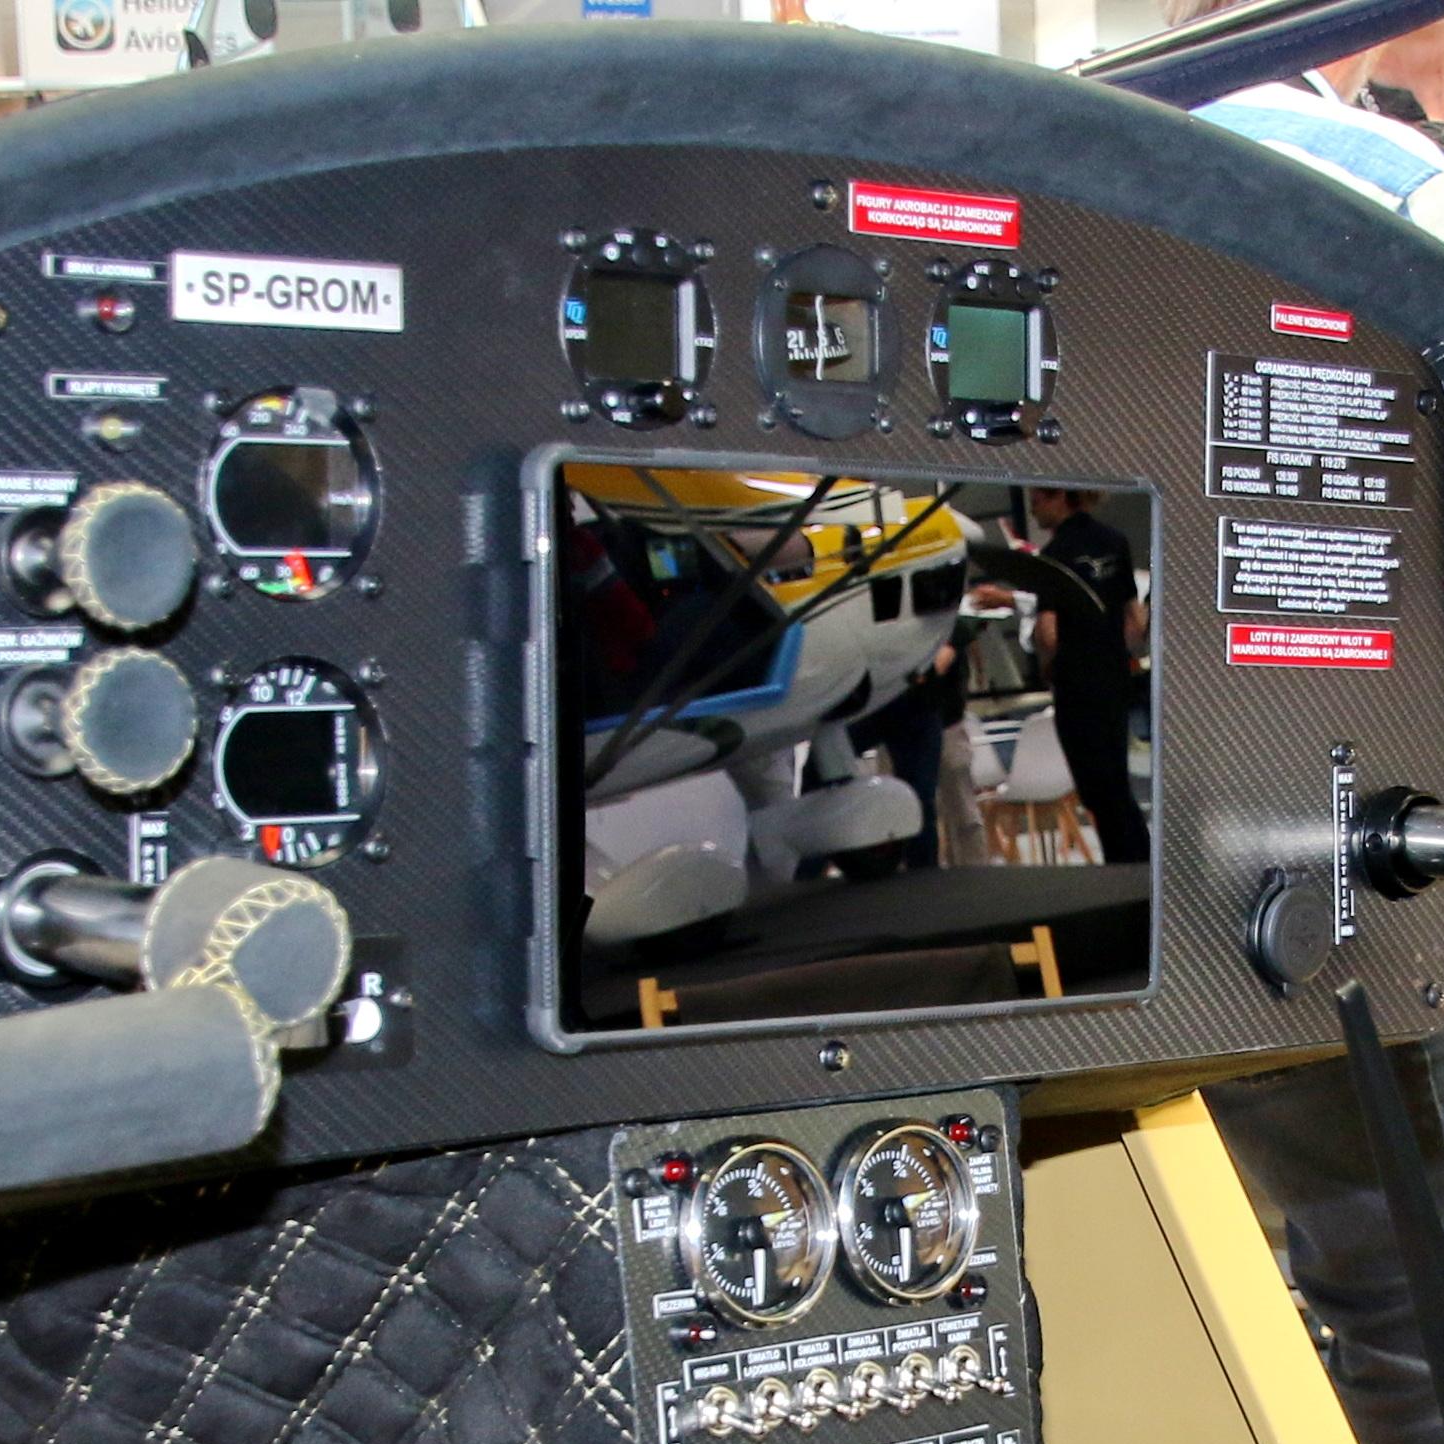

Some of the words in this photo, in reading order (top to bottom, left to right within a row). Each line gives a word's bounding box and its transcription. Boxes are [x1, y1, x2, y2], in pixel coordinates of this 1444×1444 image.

[856, 194, 893, 210] FIGURY
[894, 198, 949, 216] AKROBACJI
[954, 205, 1014, 223] ZAMIERZONY
[867, 211, 926, 232] KORKOCIĄG
[941, 218, 1003, 237] ZABRONIONE
[203, 270, 378, 315] SP-GROM
[1254, 361, 1311, 380] OGRANICZENIA
[1250, 630, 1272, 644] LOTY
[1289, 633, 1339, 647] ZAMIERZONY
[1233, 643, 1271, 658] WARUNKI
[1333, 647, 1383, 662] ZABRONIONE
[361, 972, 384, 997] R
